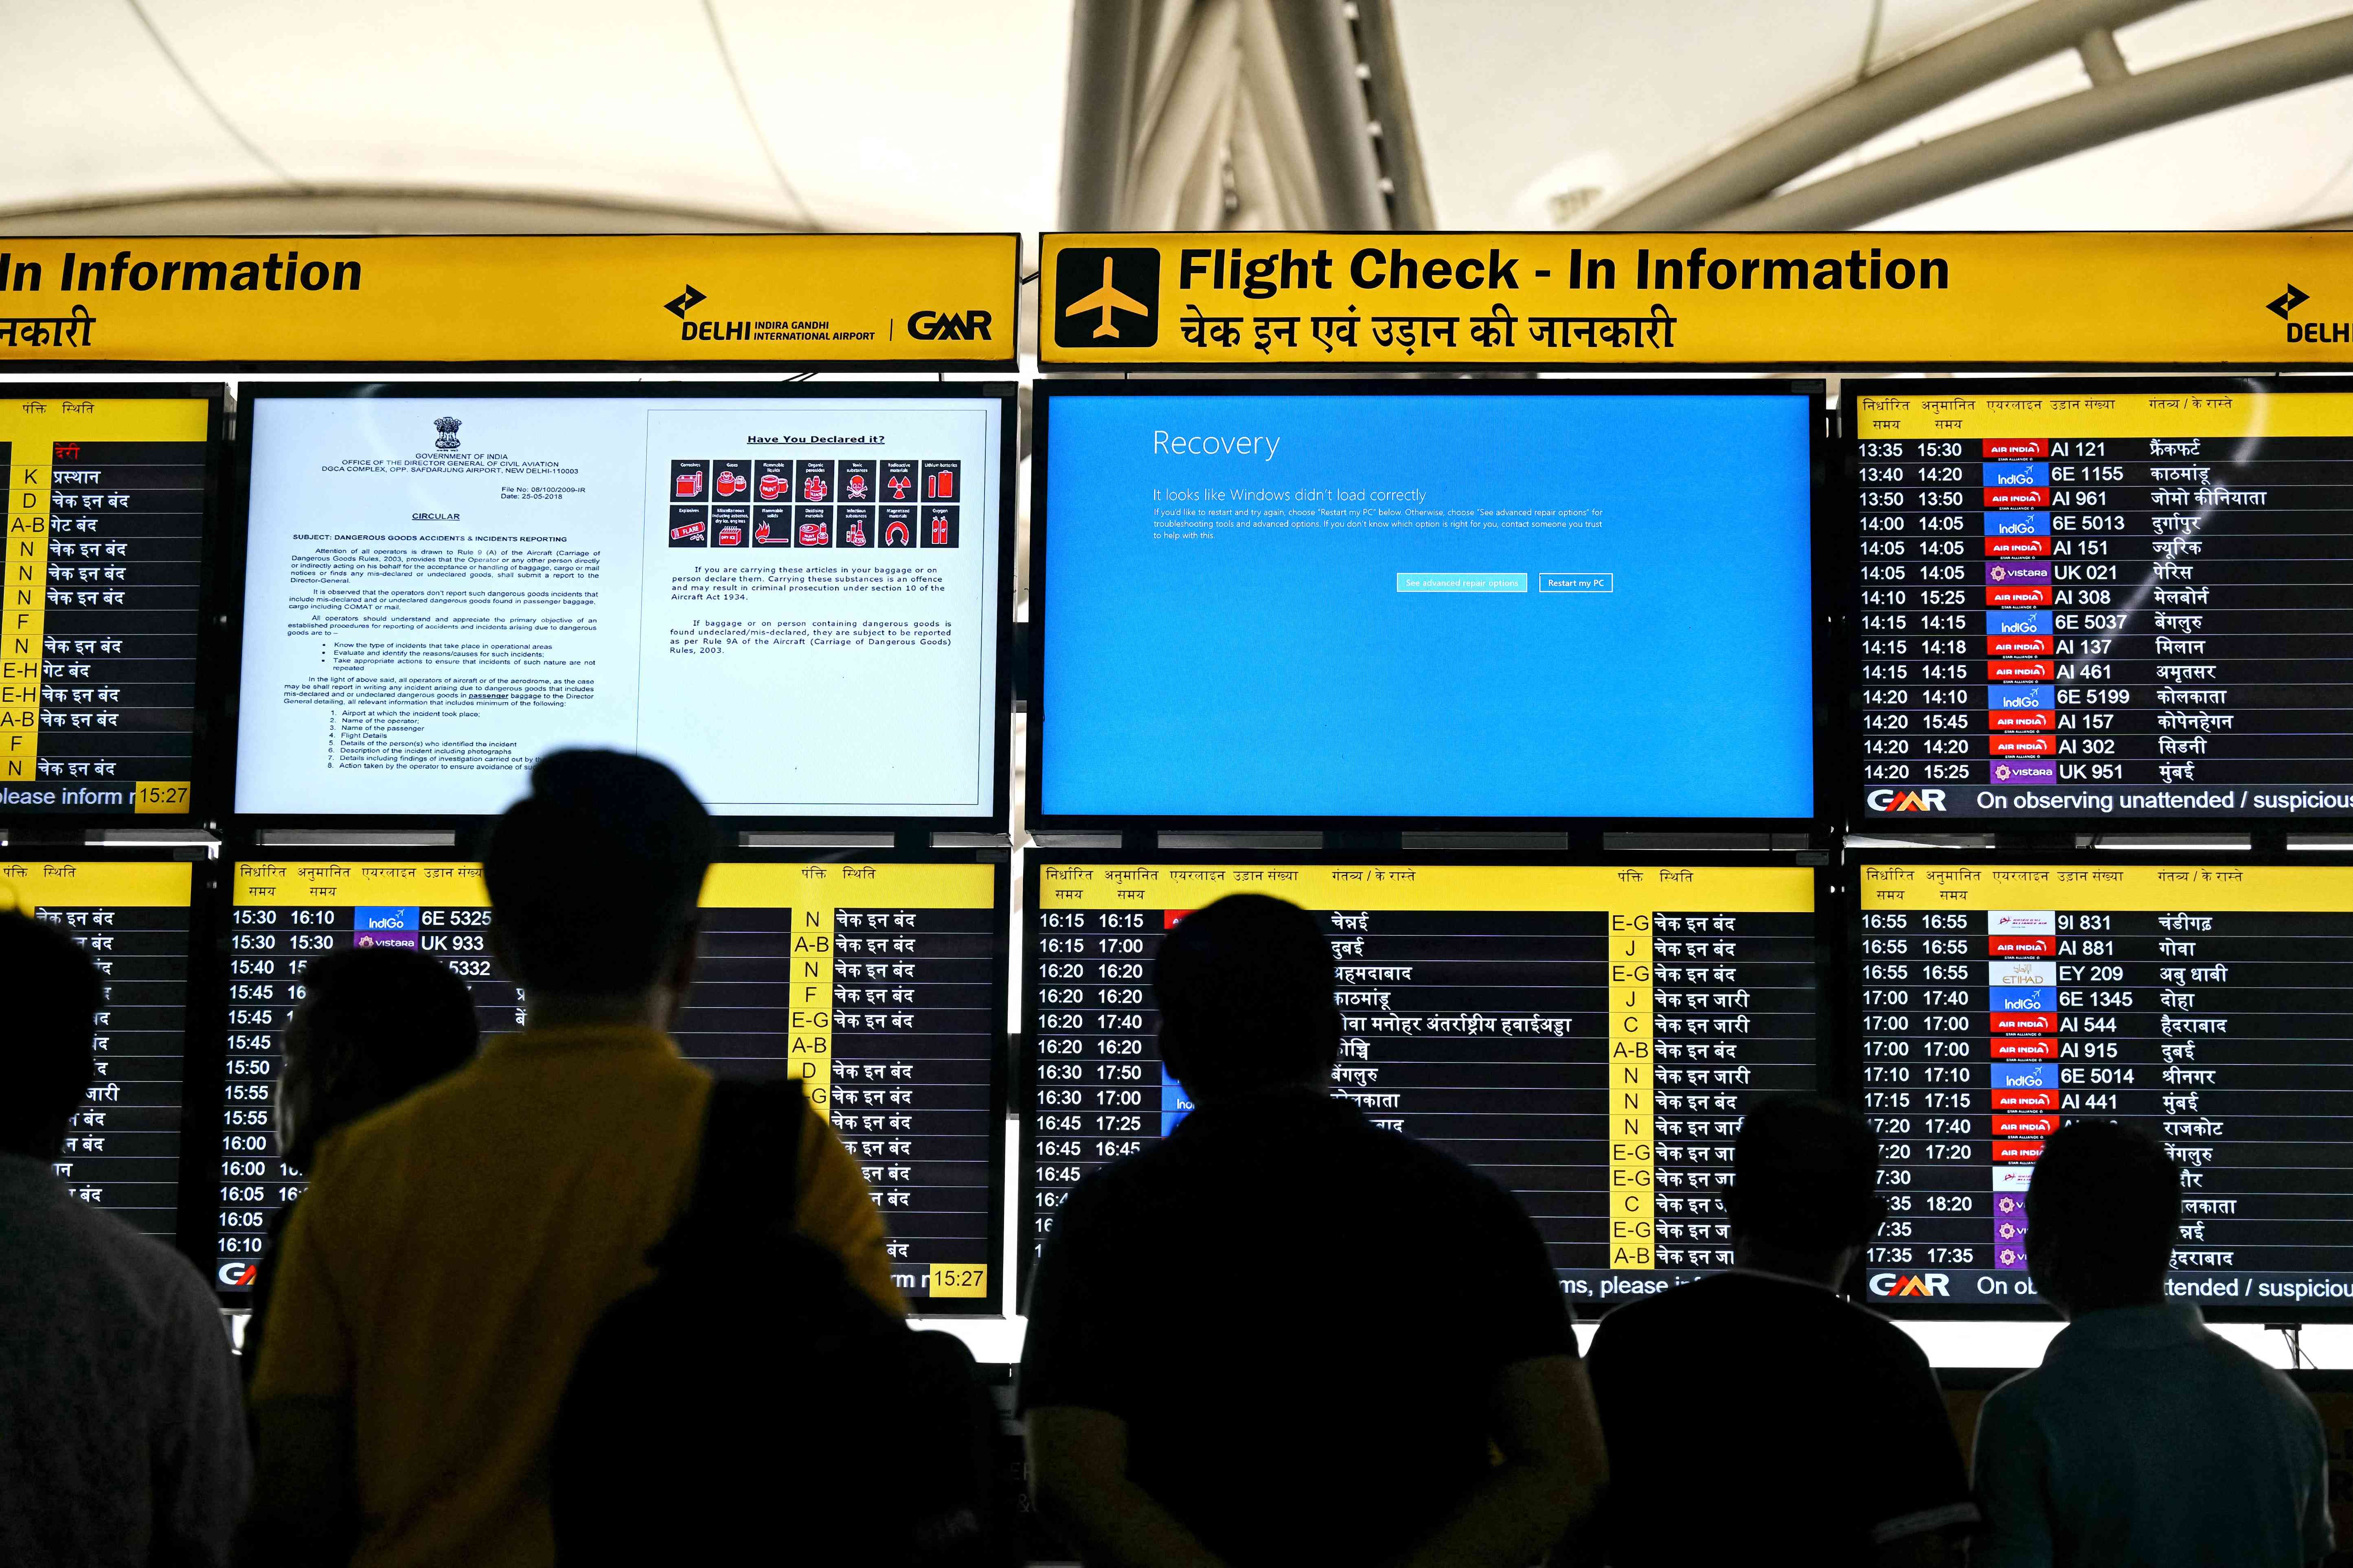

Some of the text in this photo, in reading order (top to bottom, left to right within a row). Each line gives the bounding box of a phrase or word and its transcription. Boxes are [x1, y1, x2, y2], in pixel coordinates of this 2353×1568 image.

[0, 251, 361, 291] In Information
[1180, 248, 1332, 299] Flight
[1351, 248, 1519, 289] Check
[1570, 249, 1615, 289] In
[1638, 247, 1947, 289] Information
[682, 322, 750, 340] DELHI
[908, 311, 991, 340] GMR
[1180, 303, 1677, 356] चेक इन एवं उड़ान की जानकारी
[2287, 323, 2353, 342] DELH
[23, 401, 94, 414] पंक्ति स्थिति
[1862, 397, 2115, 414] निर्धारित अनुमानित एयरलाइन उड़ान संख्या
[2149, 397, 2180, 409] गंतव्य
[2192, 396, 2202, 408] के
[2206, 396, 2232, 408] रास्ते
[55, 443, 80, 459] देरी
[1155, 431, 1280, 461] Recovery
[1859, 443, 1961, 456] 13:35 15:30
[2051, 442, 2104, 456] AI 121
[2150, 438, 2200, 456] फ्रैंकफर्ट
[25, 469, 37, 484] K
[53, 472, 101, 484] प्रस्थान
[24, 493, 36, 508] D
[52, 491, 130, 510] चेक इन बंद
[1154, 489, 1161, 500] It
[1167, 488, 1199, 500] looks
[1205, 488, 1225, 500] like
[1230, 488, 1290, 501] Windows
[1338, 488, 1364, 501] load
[1371, 488, 1426, 504] correctly
[682, 526, 699, 534] FLARE
[1164, 532, 1180, 540] help
[1463, 580, 1485, 588] repair
[1489, 580, 1518, 588] options
[63, 788, 122, 804] inform
[140, 788, 188, 803] 15:27
[1867, 789, 1946, 811] GMR
[1977, 792, 2007, 808] On
[2014, 791, 2112, 812] observing
[2120, 791, 2234, 808] unattended
[234, 911, 334, 924] 15:30 16:10
[422, 911, 491, 925] 6E 5325
[807, 912, 819, 926] N
[1041, 914, 1143, 927] 16:15 16:15
[1331, 911, 1369, 931] चेन्नई
[1863, 965, 1968, 979] 16:55 16:55
[2060, 966, 2123, 981] EY 209
[2160, 964, 2228, 986] अबु धाबी
[1864, 991, 1968, 1005] 17:00 17:40
[2060, 992, 2132, 1006] 6E 1345
[2160, 989, 2195, 1011] दोहा
[1371, 1014, 1422, 1036] मनोहर
[1427, 1014, 1497, 1035] अंतर्राष्ट्रीय
[1655, 1014, 1750, 1034] चेक इन जारी
[86, 1083, 120, 1101] जारी
[935, 1271, 983, 1286] 15:27
[1601, 1277, 1668, 1298] please
